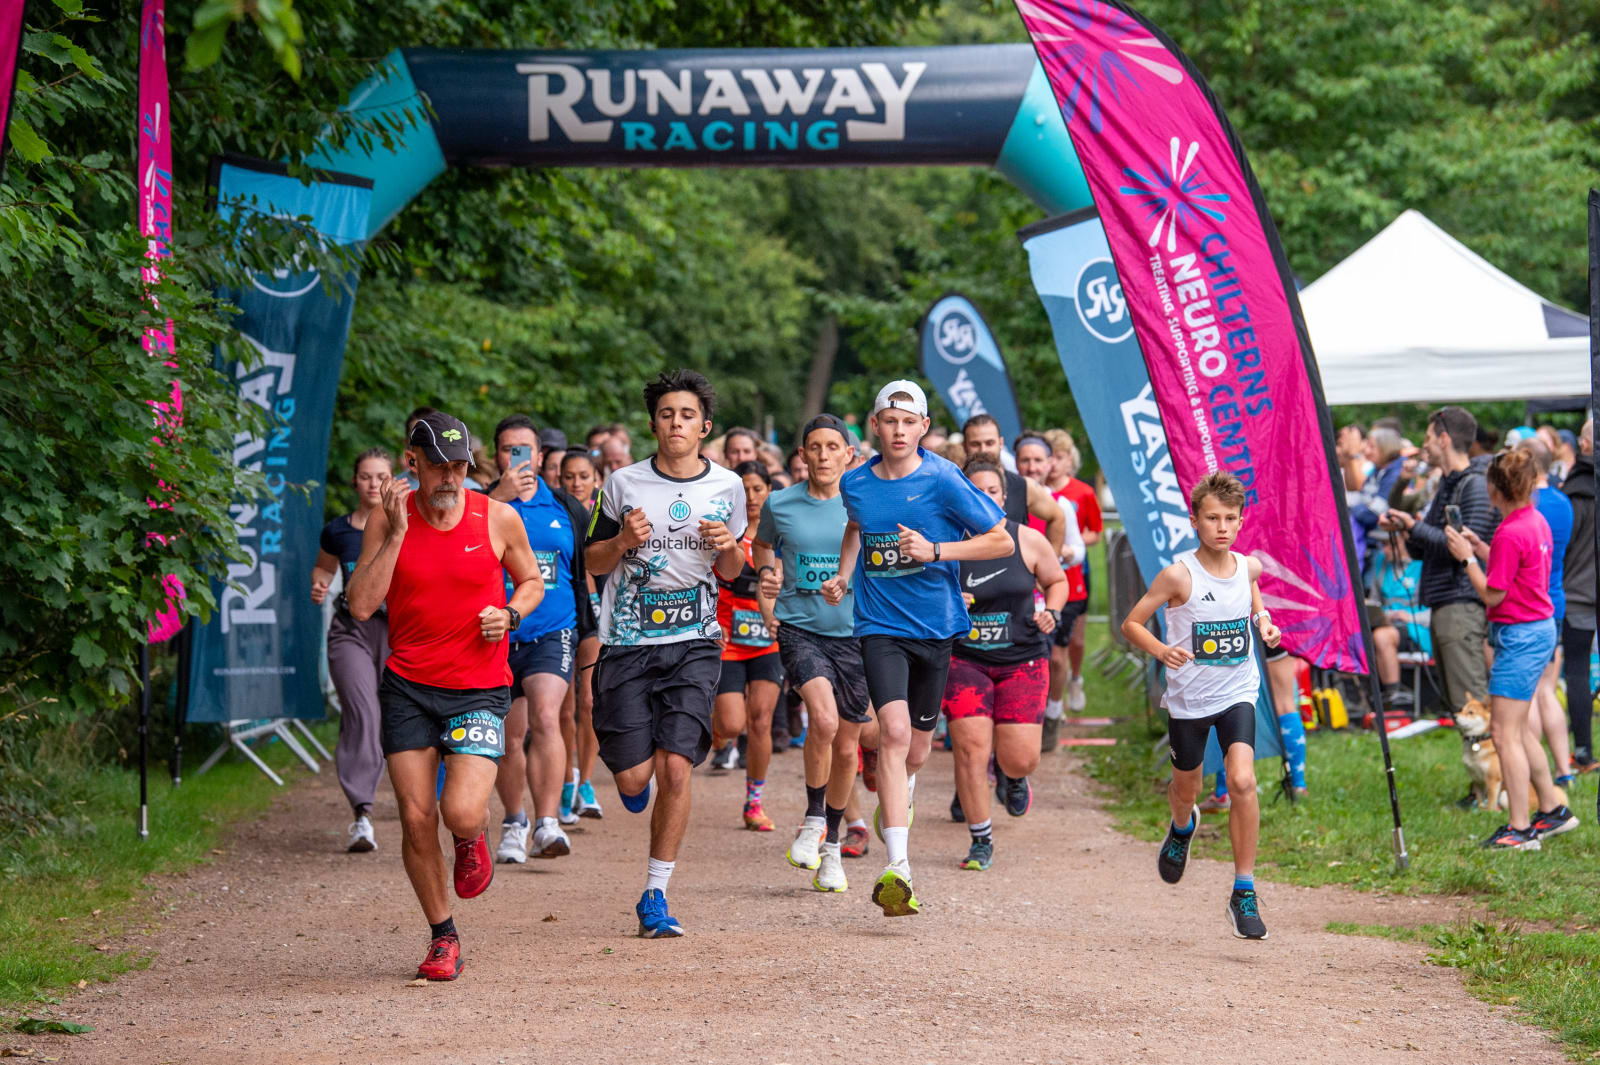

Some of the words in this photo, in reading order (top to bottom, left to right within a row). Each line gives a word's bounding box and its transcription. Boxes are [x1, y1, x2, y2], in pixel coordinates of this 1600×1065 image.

[516, 62, 927, 142] RUNAWAY
[621, 120, 840, 150] RACING
[1169, 252, 1228, 377] NEURO
[1200, 233, 1272, 417] CHILTERNS
[1149, 253, 1175, 316] TREATING,
[1167, 316, 1200, 396] SUPPORTING
[1190, 396, 1201, 407] &
[261, 398, 296, 555] RACING
[864, 534, 900, 547] RUNAW
[640, 588, 699, 605] RUNAWAY
[657, 598, 689, 607] RACING
[1195, 619, 1247, 636] RUNAWAY
[1210, 628, 1241, 637] RACING
[449, 711, 502, 730] RUNAWAY
